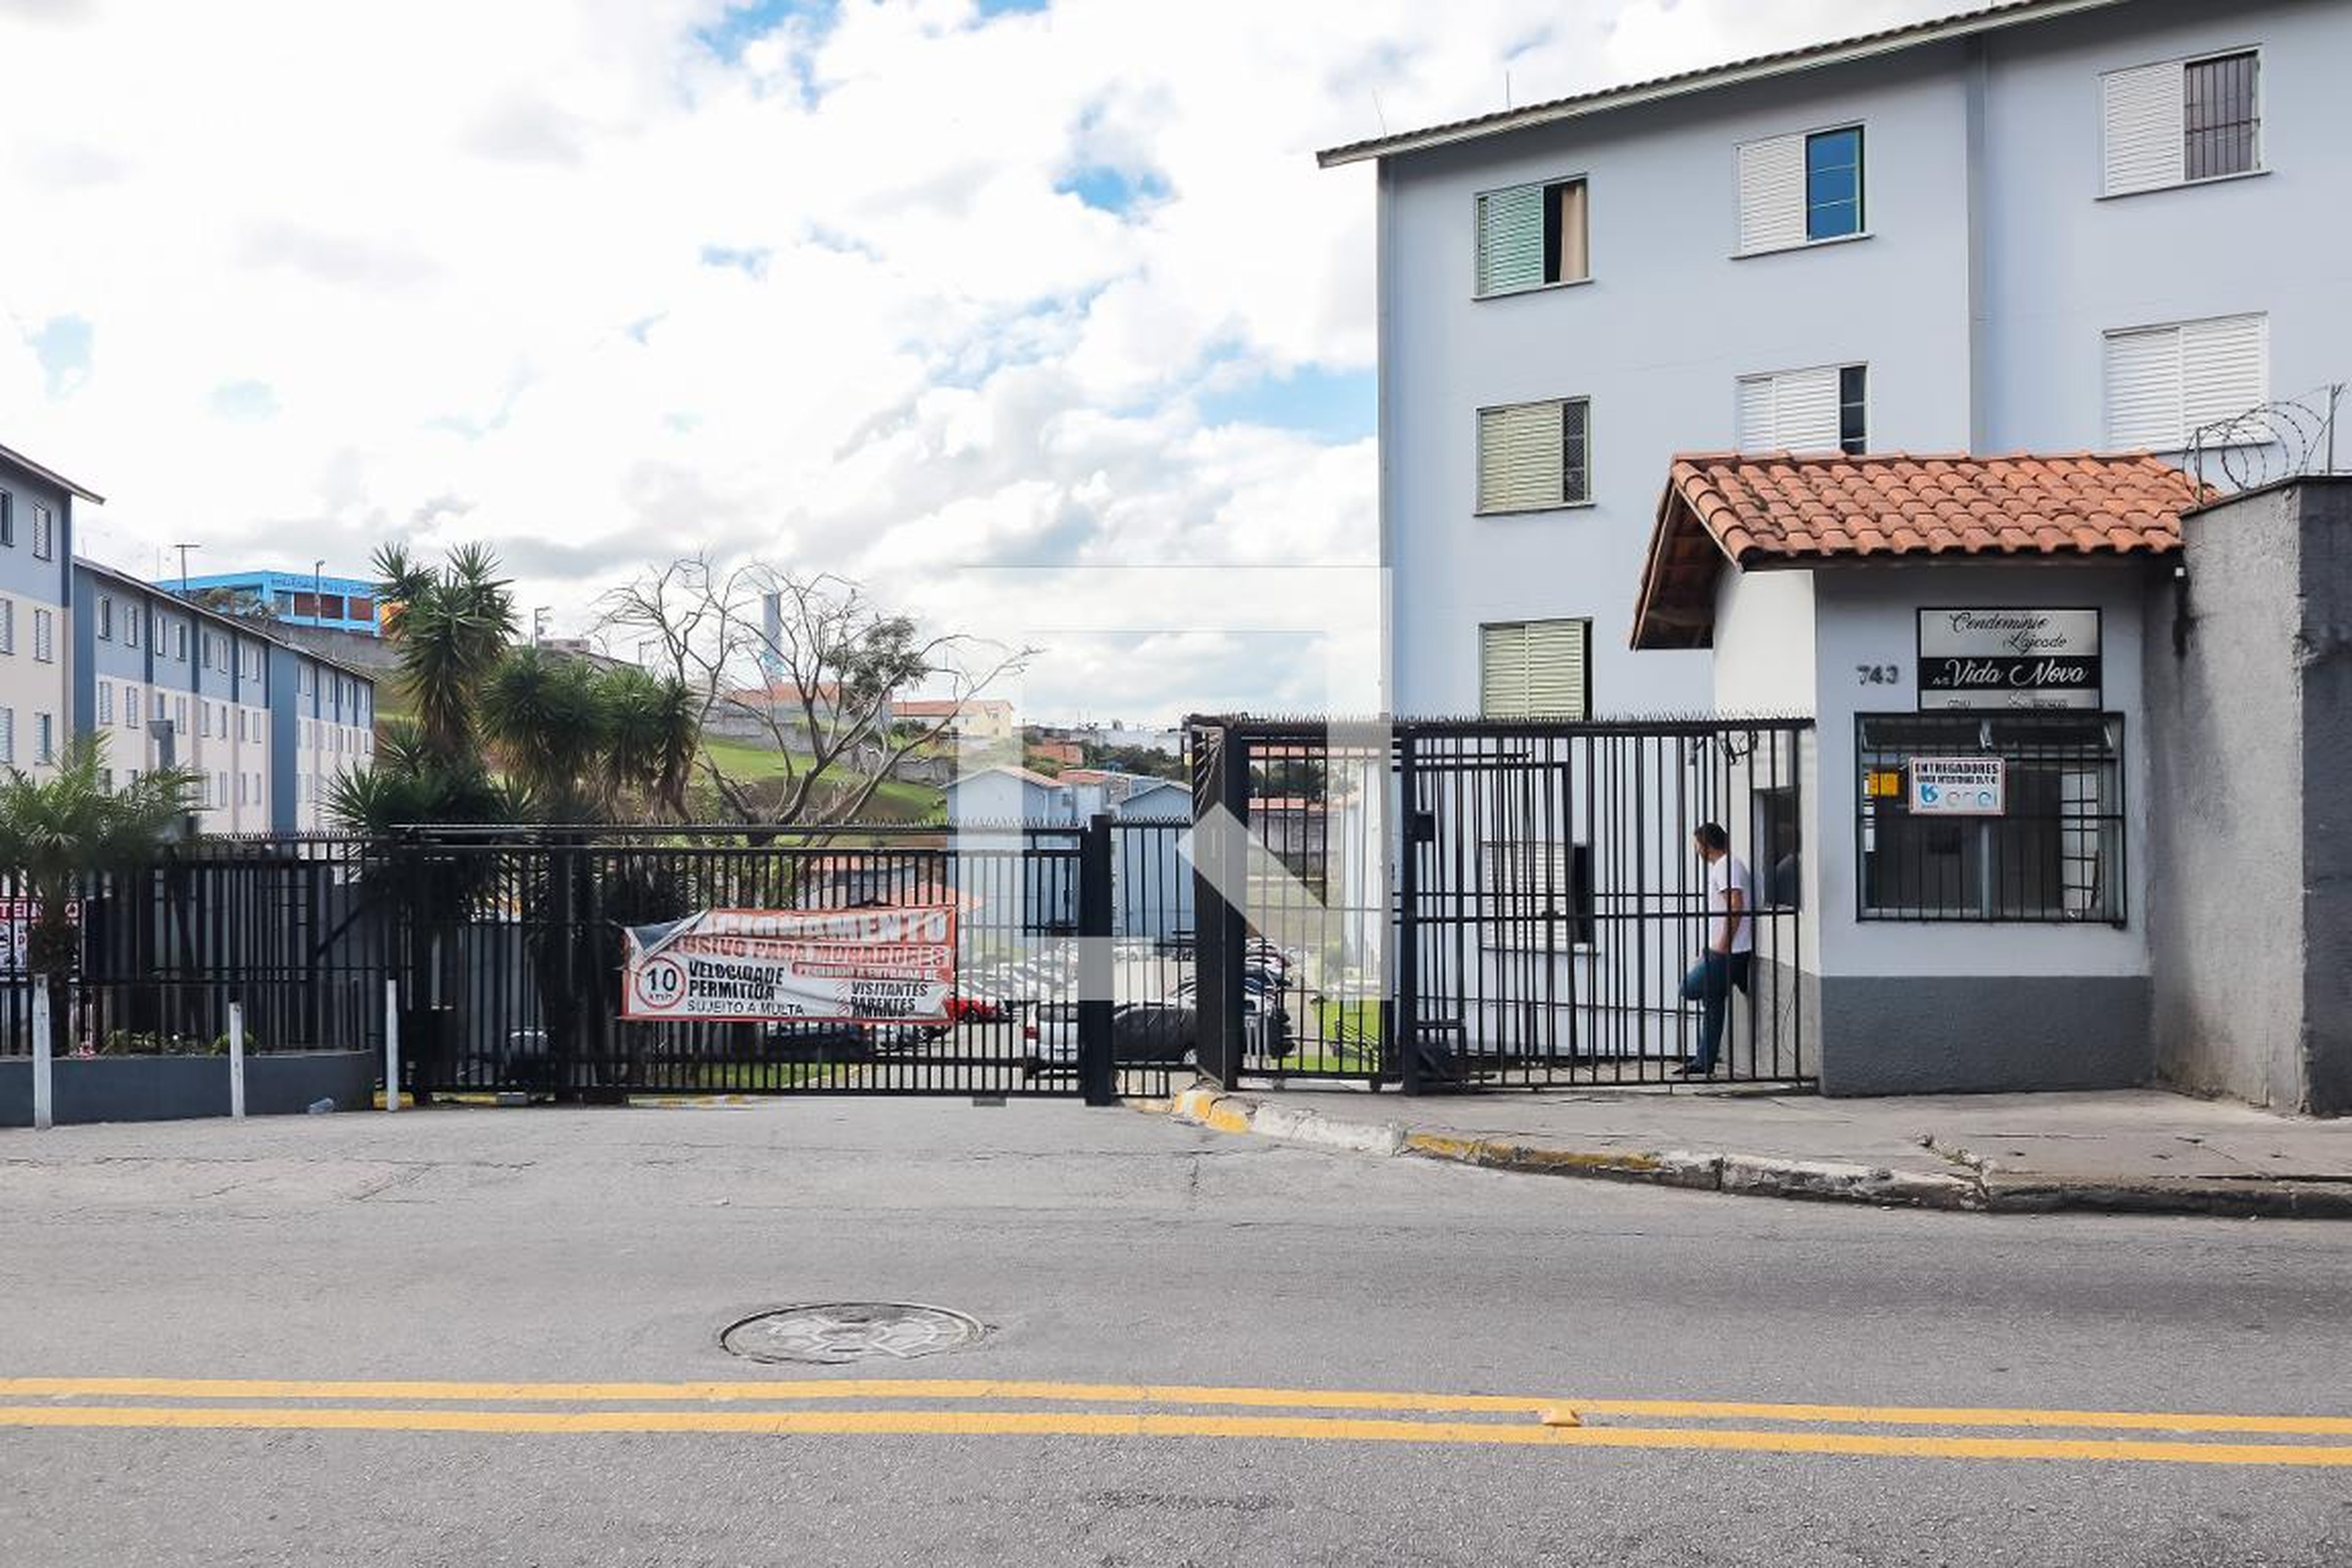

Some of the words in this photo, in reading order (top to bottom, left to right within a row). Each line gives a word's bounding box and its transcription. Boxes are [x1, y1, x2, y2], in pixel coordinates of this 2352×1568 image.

[1856, 665, 1898, 685] 743
[1945, 659, 2004, 687] Vida
[2010, 658, 2089, 686] Nova
[1915, 763, 1999, 774] ENTREGADORES
[647, 967, 677, 992] 10
[689, 961, 785, 985] VELOCIDADE
[688, 980, 775, 1000] PERMITIDA
[851, 982, 928, 997] VISITANTES
[688, 1000, 744, 1014] SUJEITO
[747, 1003, 757, 1014] A
[761, 1003, 805, 1016] MULTA
